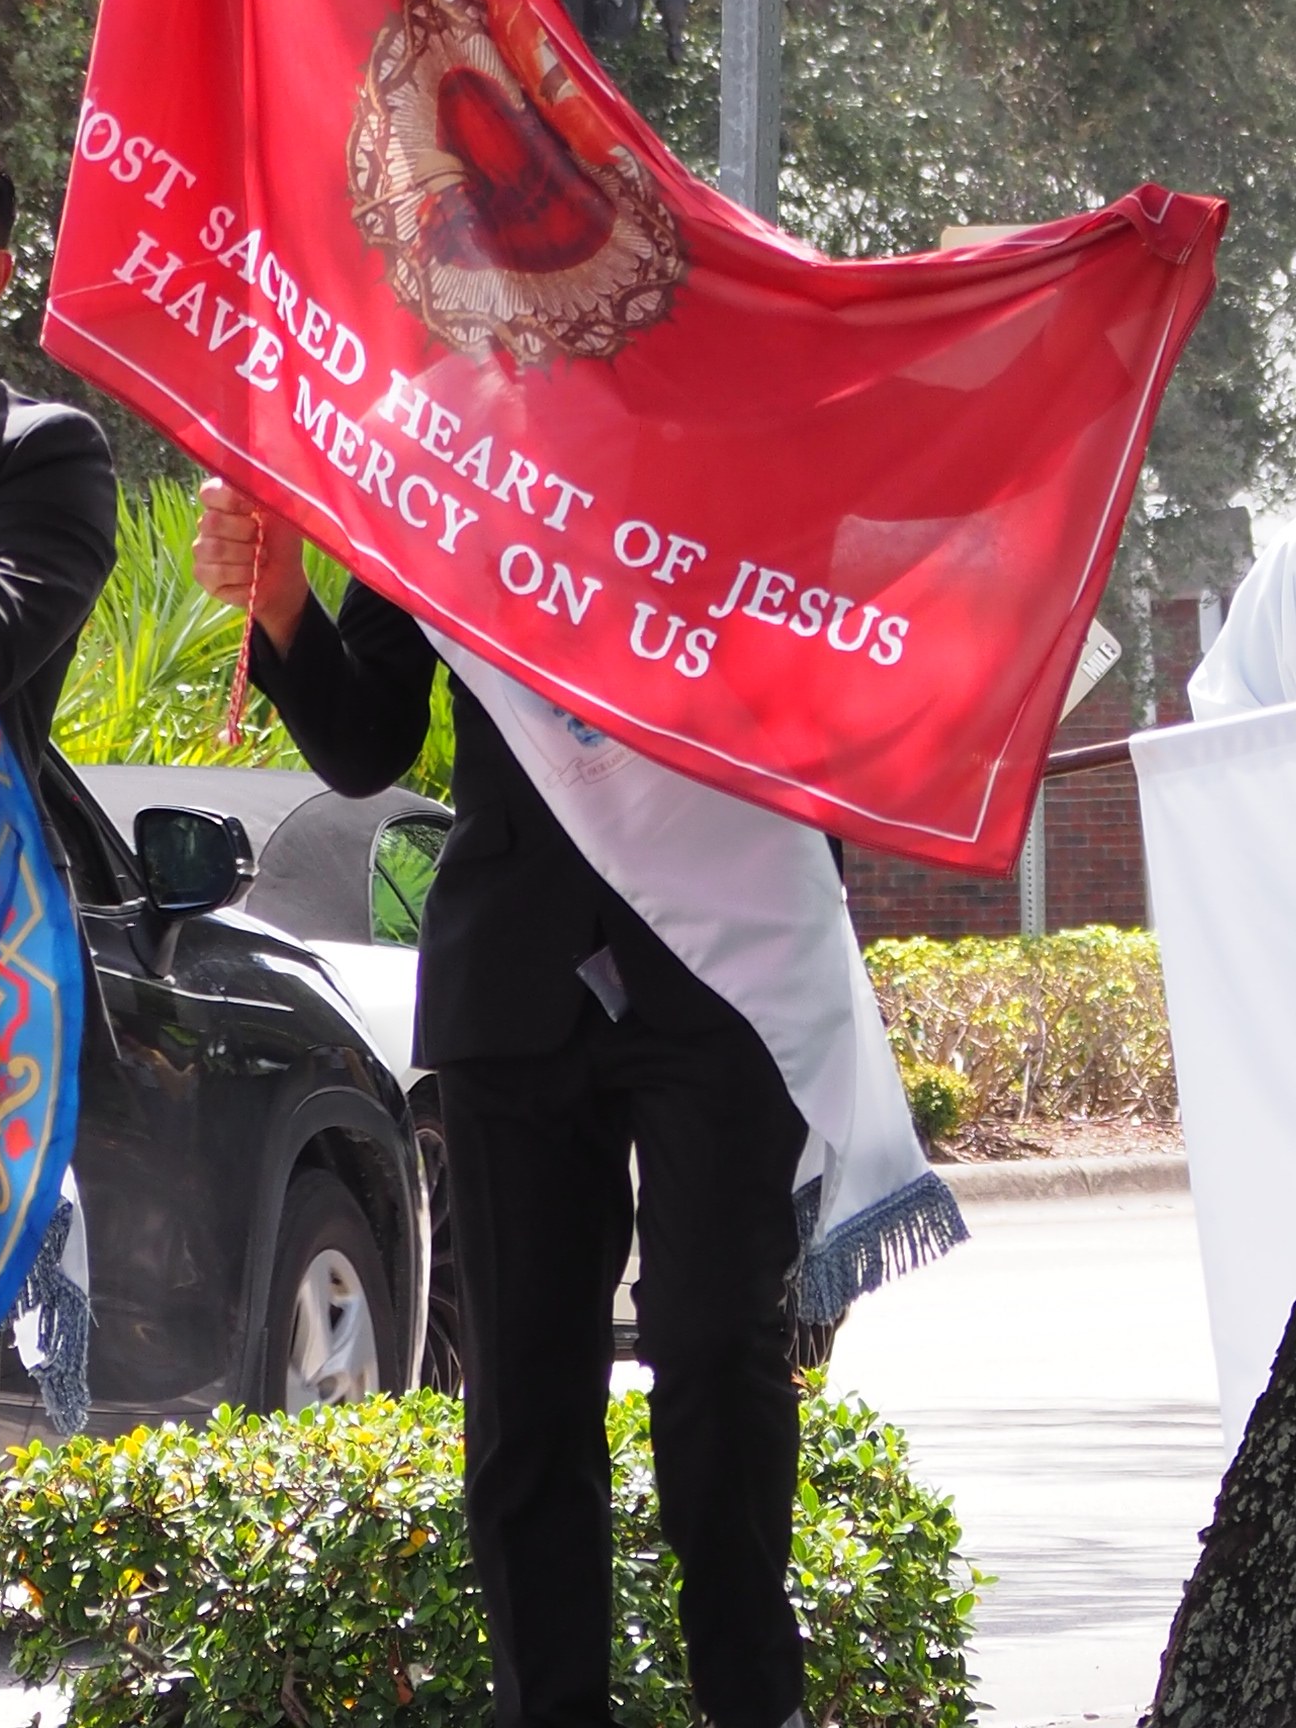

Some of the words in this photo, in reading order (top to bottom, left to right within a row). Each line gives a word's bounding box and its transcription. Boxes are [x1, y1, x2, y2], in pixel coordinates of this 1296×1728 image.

[112, 231, 284, 394] HAVE
[293, 385, 479, 556] MERCY
[501, 545, 604, 627] ON
[630, 605, 718, 679] US
[198, 206, 367, 386] SACRED
[379, 367, 593, 531] HEART
[613, 519, 707, 585] OF
[709, 559, 910, 667] JESUS
